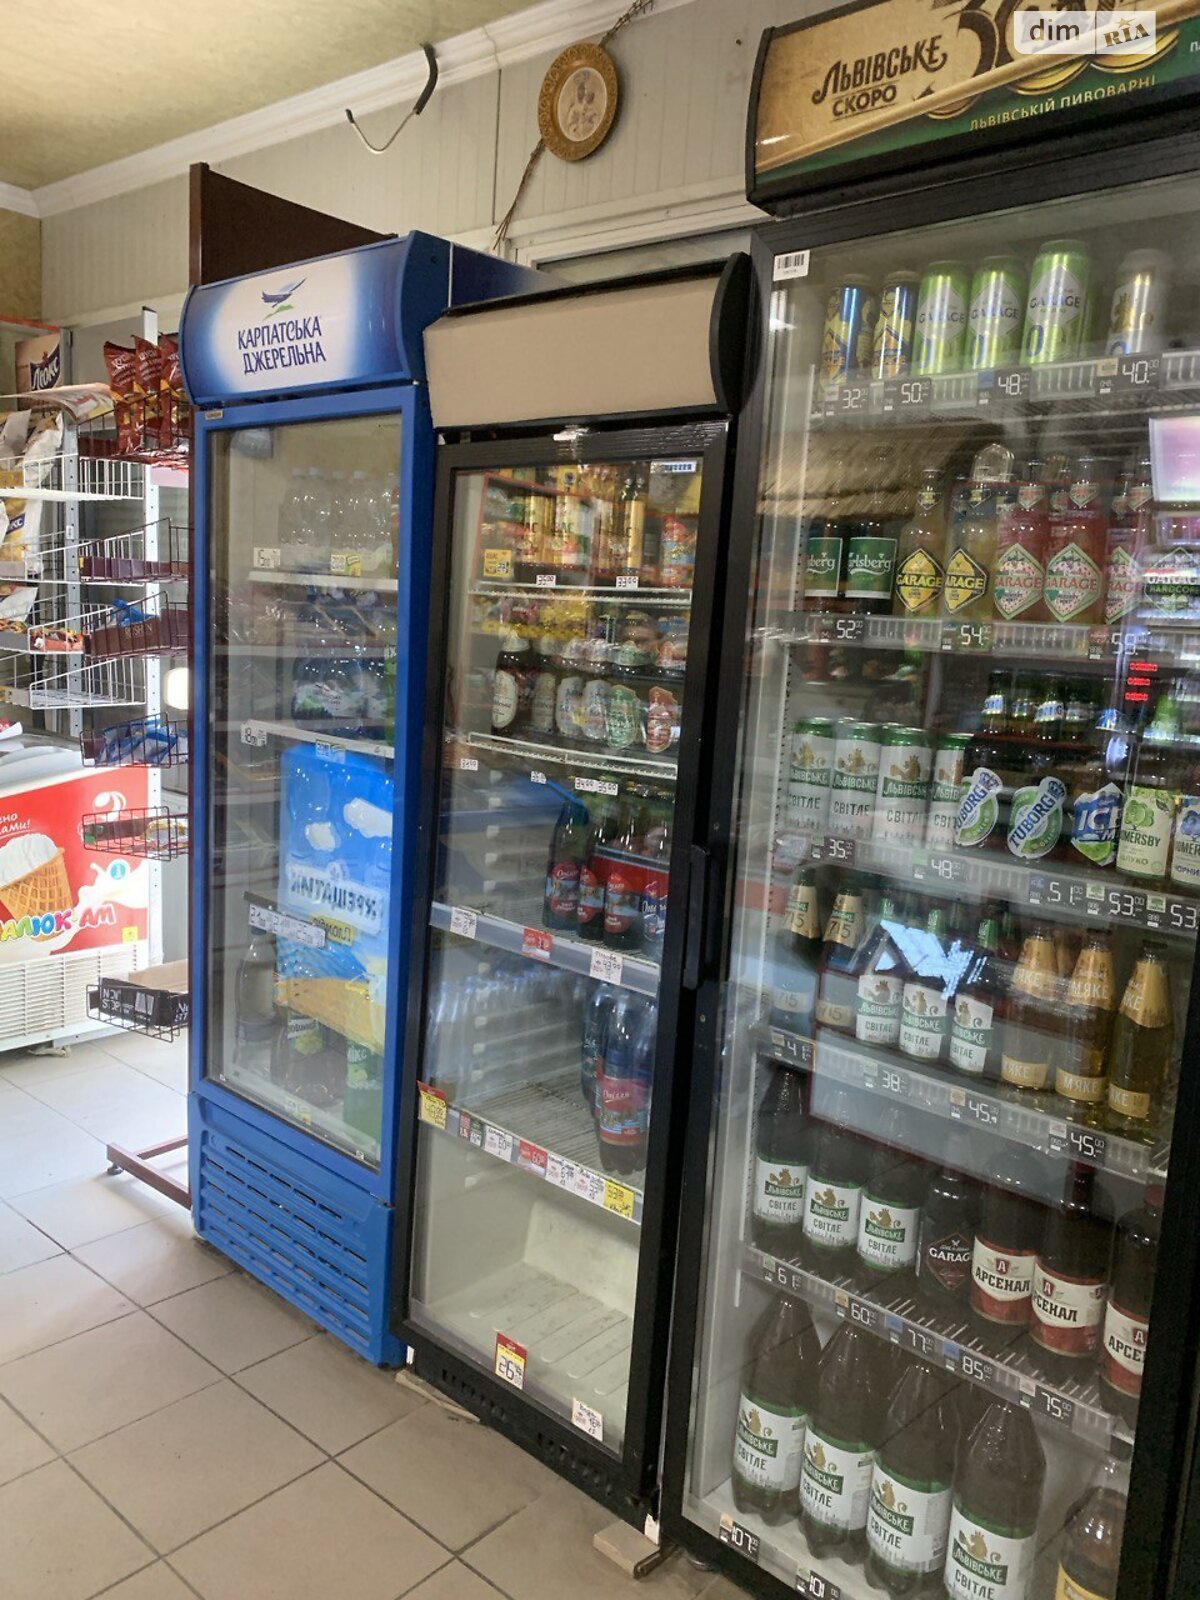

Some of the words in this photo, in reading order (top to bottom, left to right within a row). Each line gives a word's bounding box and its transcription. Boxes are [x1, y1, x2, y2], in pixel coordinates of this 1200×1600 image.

[811, 34, 948, 106] ЛЬВІВСЬКЕ
[831, 84, 897, 118] СКОРО
[969, 98, 1056, 131] ЛЬВІВСЬКІЙ
[1060, 75, 1156, 109] ПИВОВАРНІ
[238, 316, 321, 350] КАРПАТСЬКА
[243, 341, 327, 375] ДЖЕРЕЛЬНА
[848, 553, 892, 572] rlsberg
[833, 800, 871, 817] СВІТЛЕ
[886, 809, 920, 824] СВІТЛ
[1009, 794, 1057, 848] TUBORG
[0, 909, 72, 942] АЛЮК
[769, 1199, 797, 1211] СВІТЛЕ
[813, 1218, 842, 1233] СВІТЛЕ
[868, 1239, 897, 1255] СВІТЛЕ
[929, 1247, 970, 1262] GARAG
[975, 1266, 1030, 1292] АРСЕНАЛ
[1108, 1335, 1144, 1363] АРСЕ
[802, 1477, 833, 1509] СВІТЛЕ
[870, 1515, 902, 1550] СВІТЛЕ
[953, 1545, 1004, 1582] ЛЬВІВСЬКЕ
[955, 1568, 995, 1600] СВІТЛЕ
